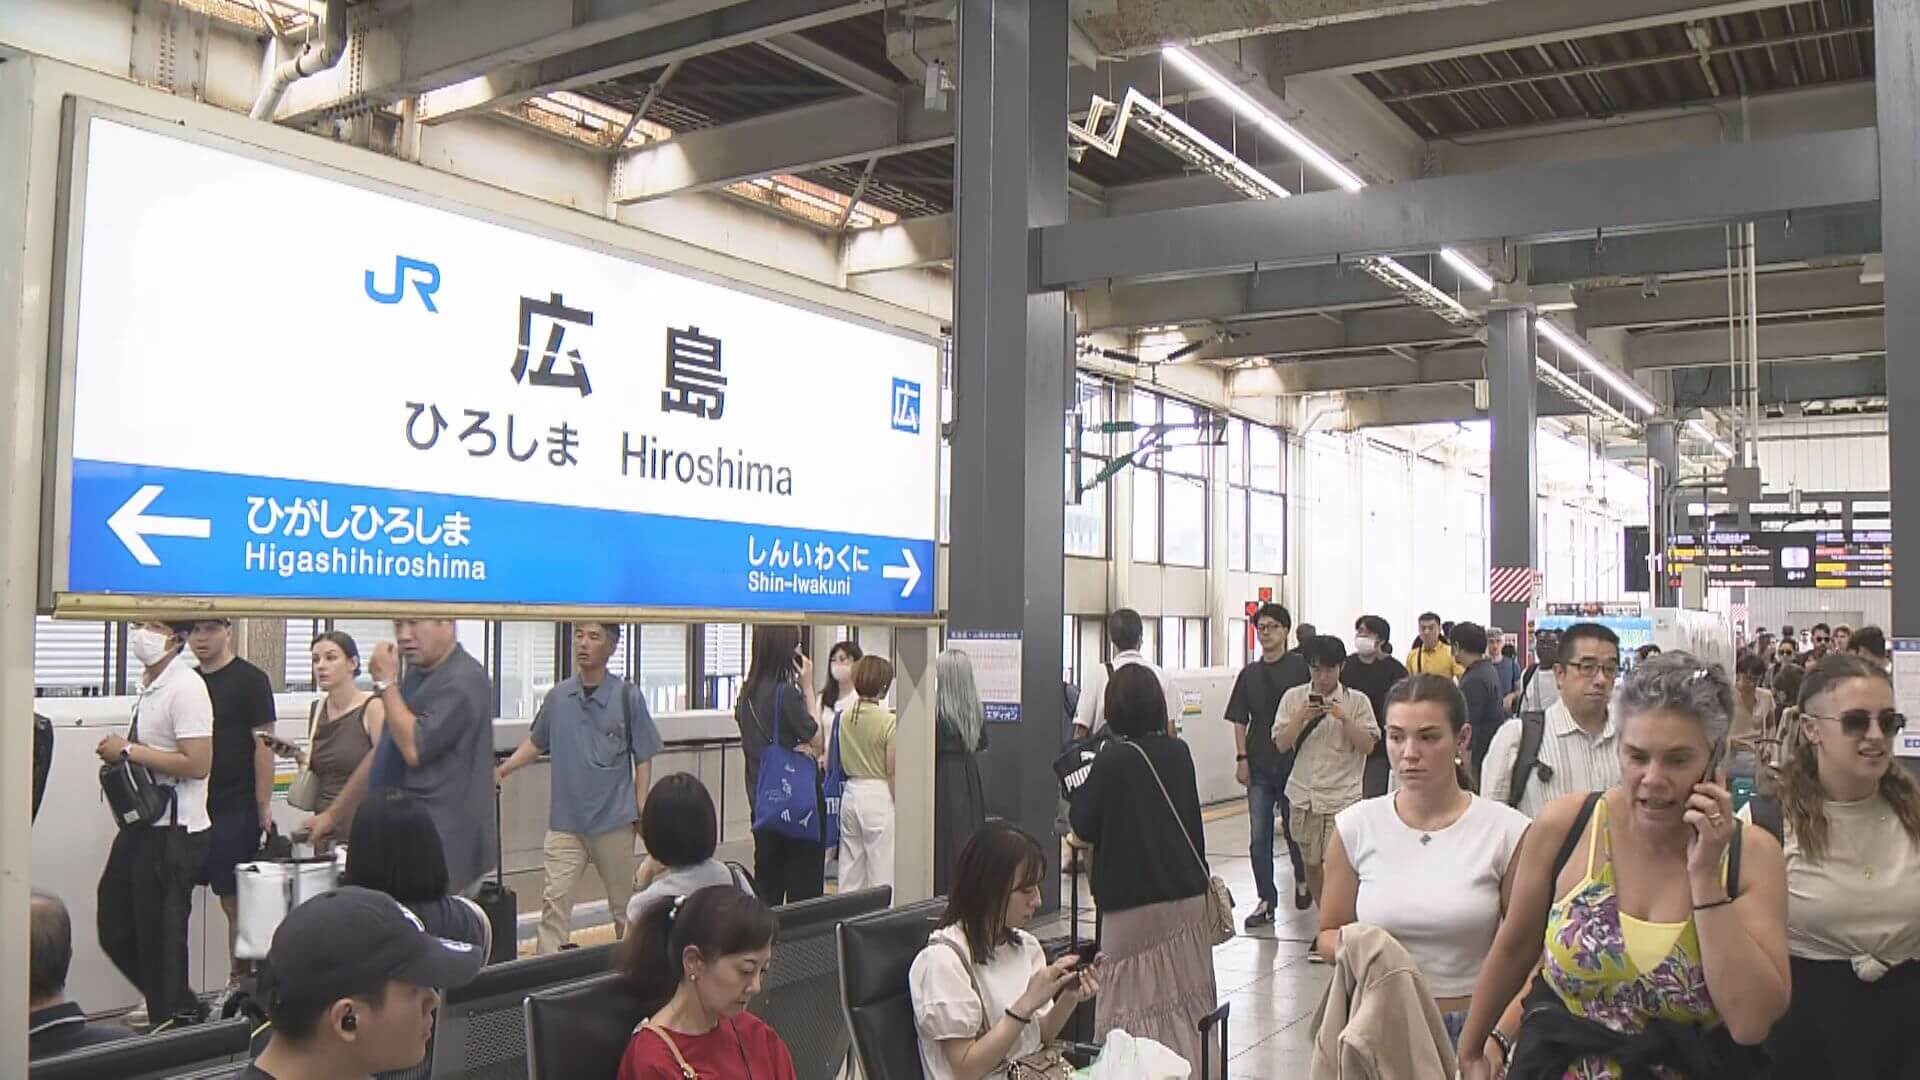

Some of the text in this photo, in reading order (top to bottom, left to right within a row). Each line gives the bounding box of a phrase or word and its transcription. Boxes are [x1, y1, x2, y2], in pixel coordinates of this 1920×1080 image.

[364, 255, 441, 313] JR
[510, 292, 728, 420] 広島
[892, 381, 920, 431] 広
[406, 402, 793, 496] ひろしま Hiroshima
[247, 495, 471, 548] ひがしひろしま
[245, 541, 486, 580] Higashihiroshima
[748, 535, 870, 573] しんいわくに
[748, 571, 852, 597] Shin-Iwakuni
[1064, 762, 1093, 793] PUM
